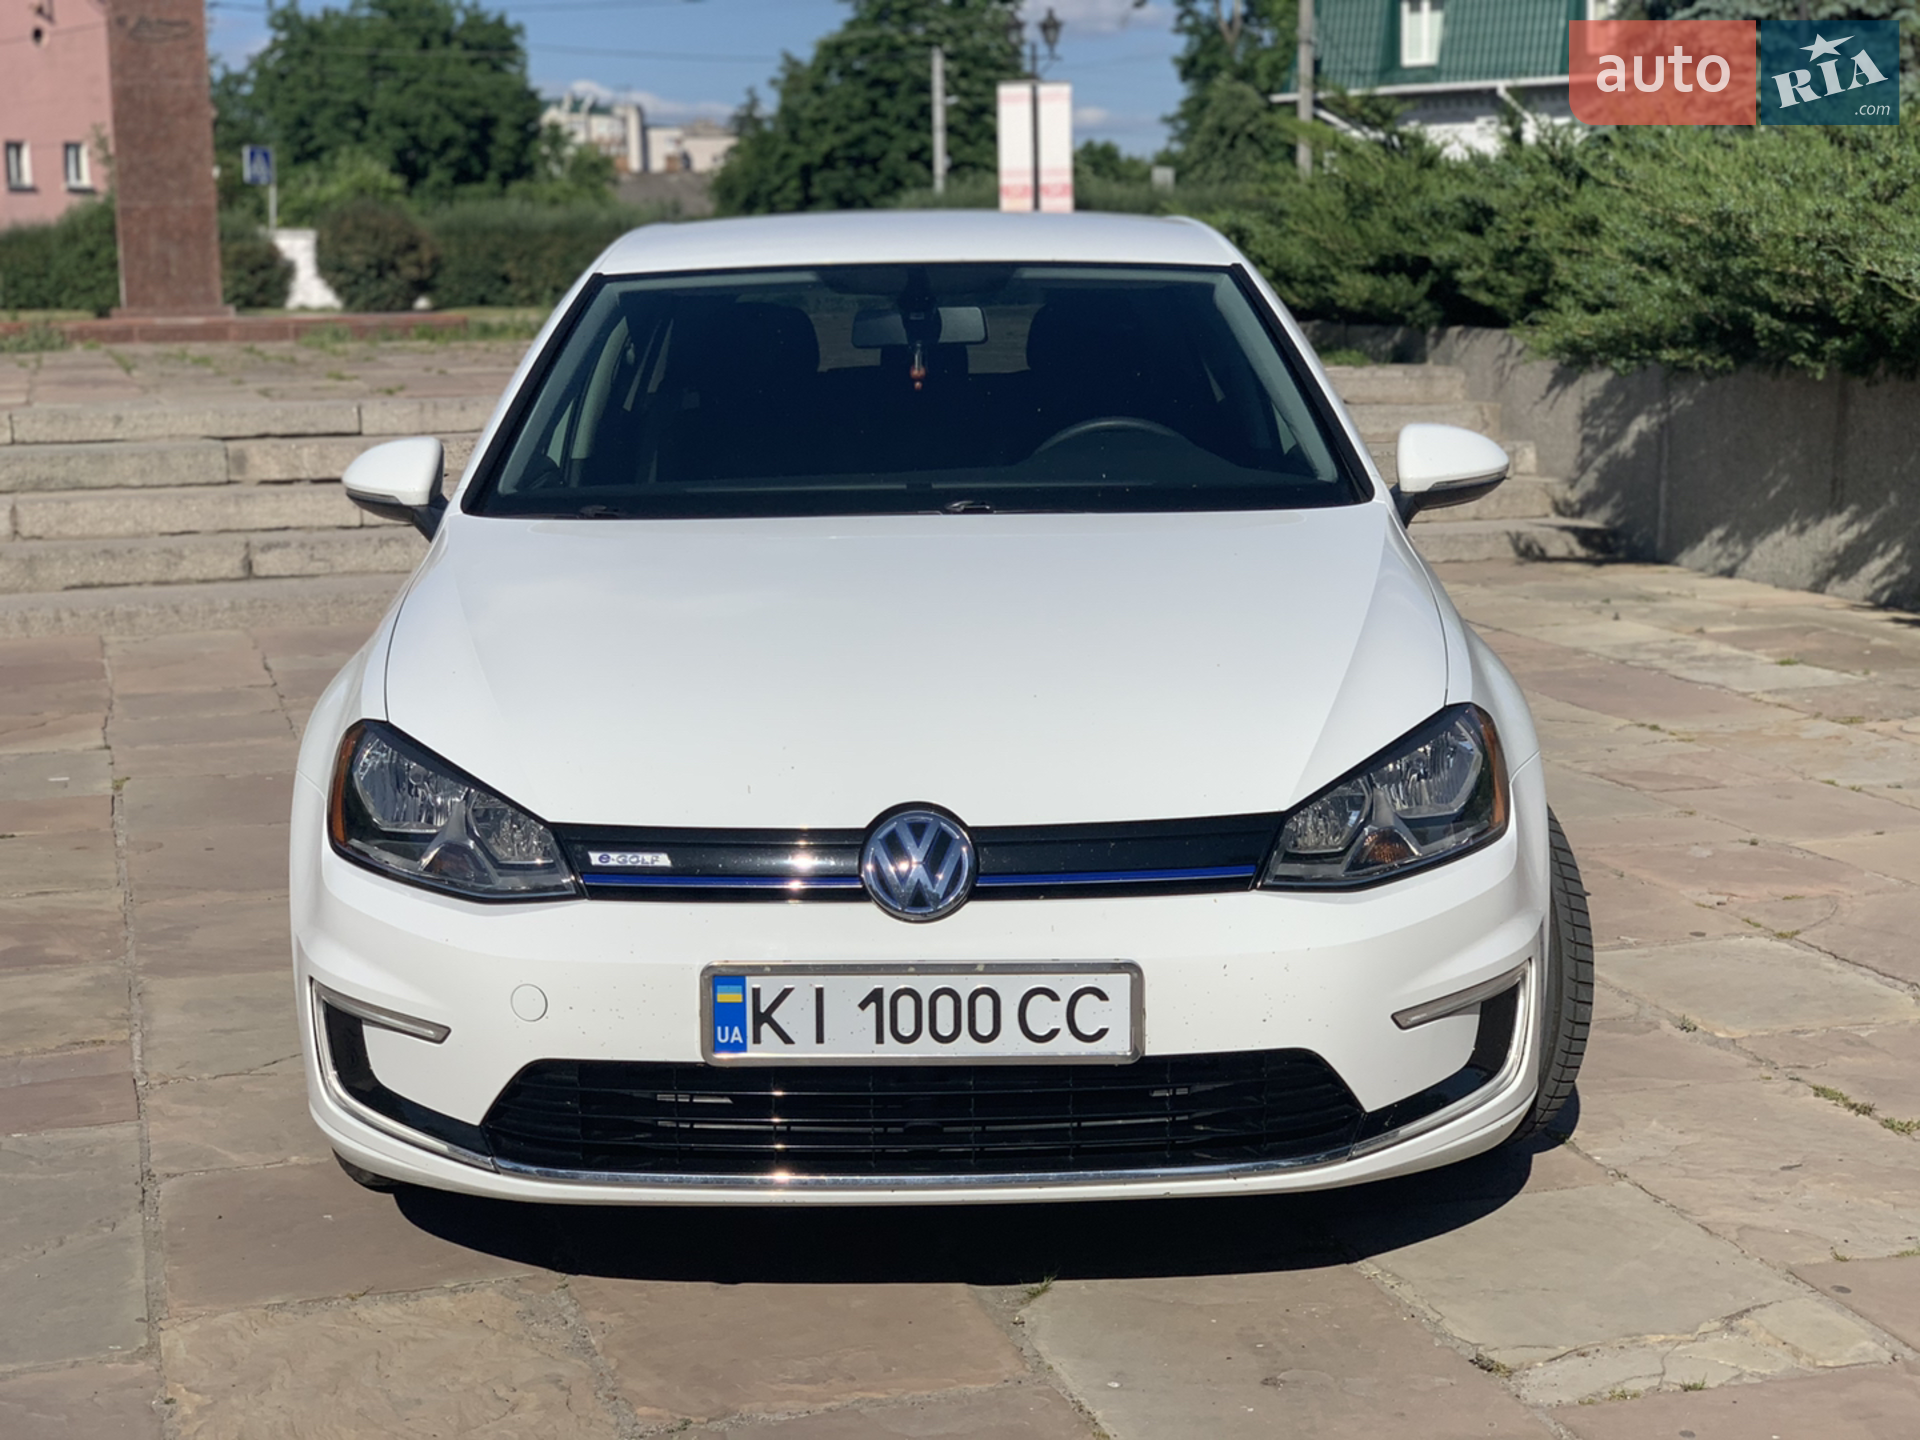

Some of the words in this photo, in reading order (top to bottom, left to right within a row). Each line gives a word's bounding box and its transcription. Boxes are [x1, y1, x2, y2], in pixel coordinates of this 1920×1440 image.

[751, 984, 825, 1045] KI
[857, 984, 1001, 1045] 1000
[1017, 984, 1110, 1044] CC
[717, 1026, 743, 1044] UA
